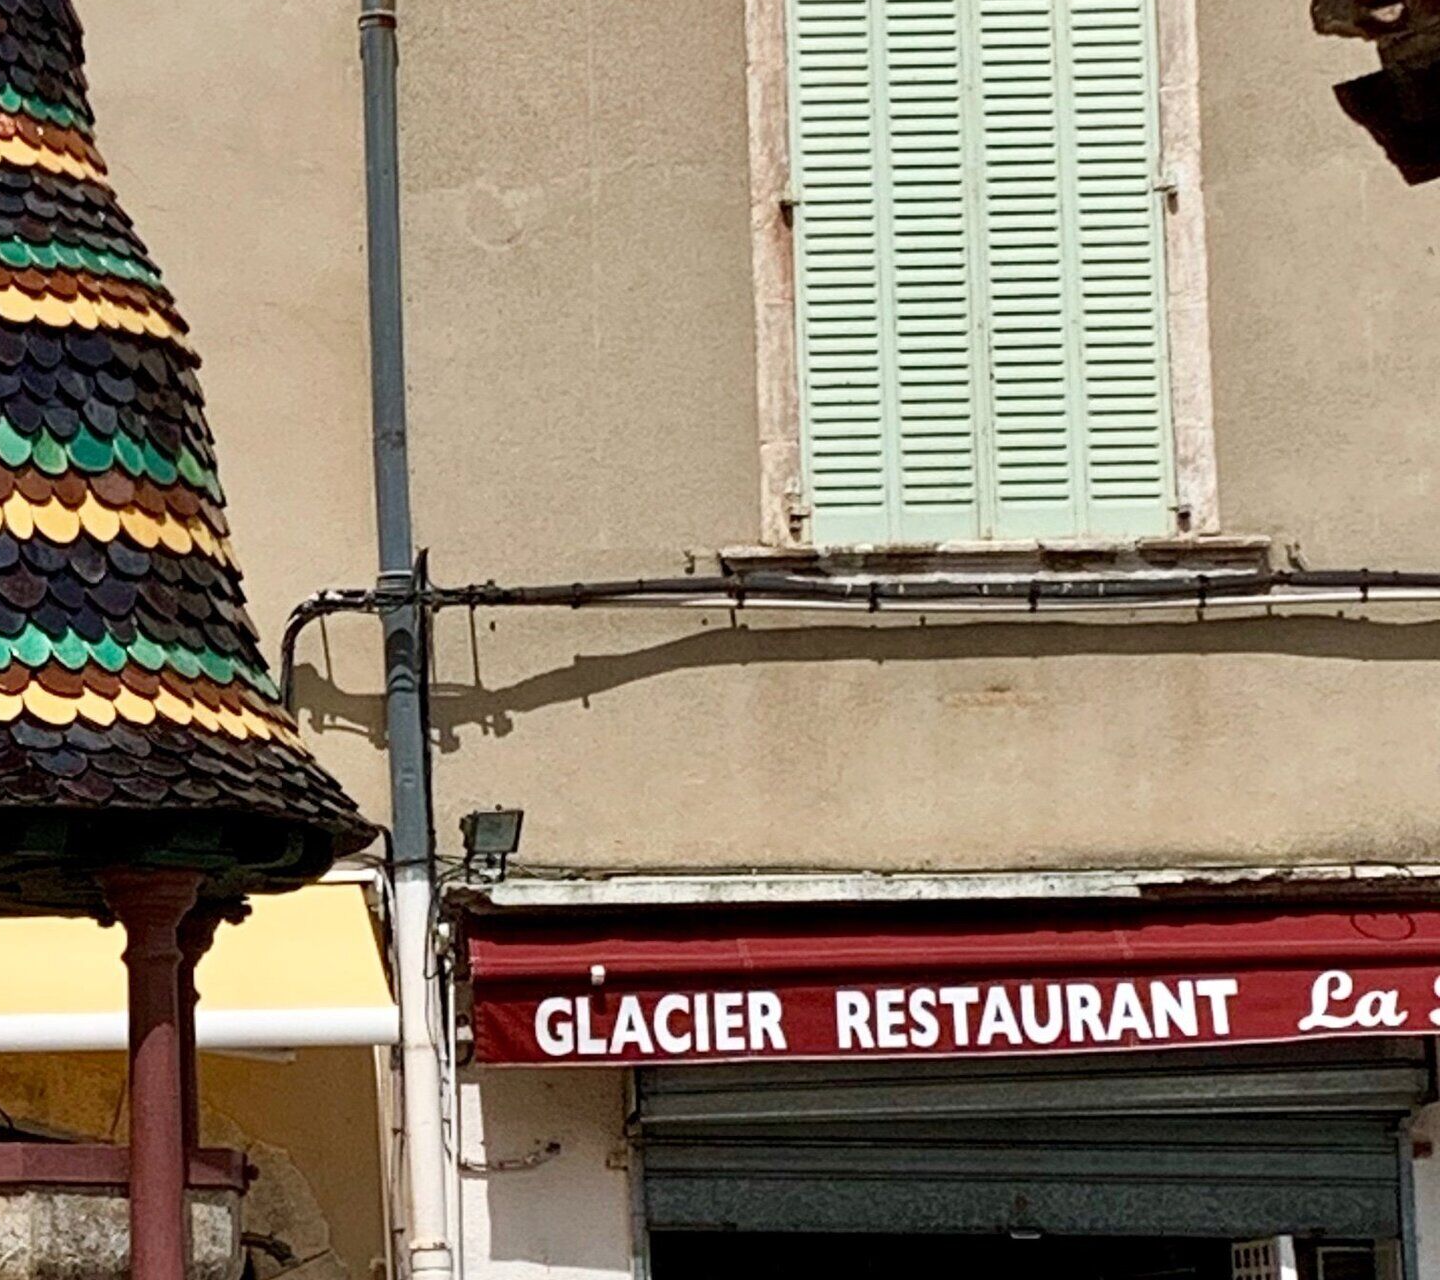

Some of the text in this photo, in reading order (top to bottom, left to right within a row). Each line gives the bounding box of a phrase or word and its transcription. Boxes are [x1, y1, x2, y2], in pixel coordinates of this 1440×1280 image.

[533, 989, 787, 1056] GLACIER
[836, 978, 1238, 1050] RESTAURANT
[1297, 969, 1409, 1031] La
